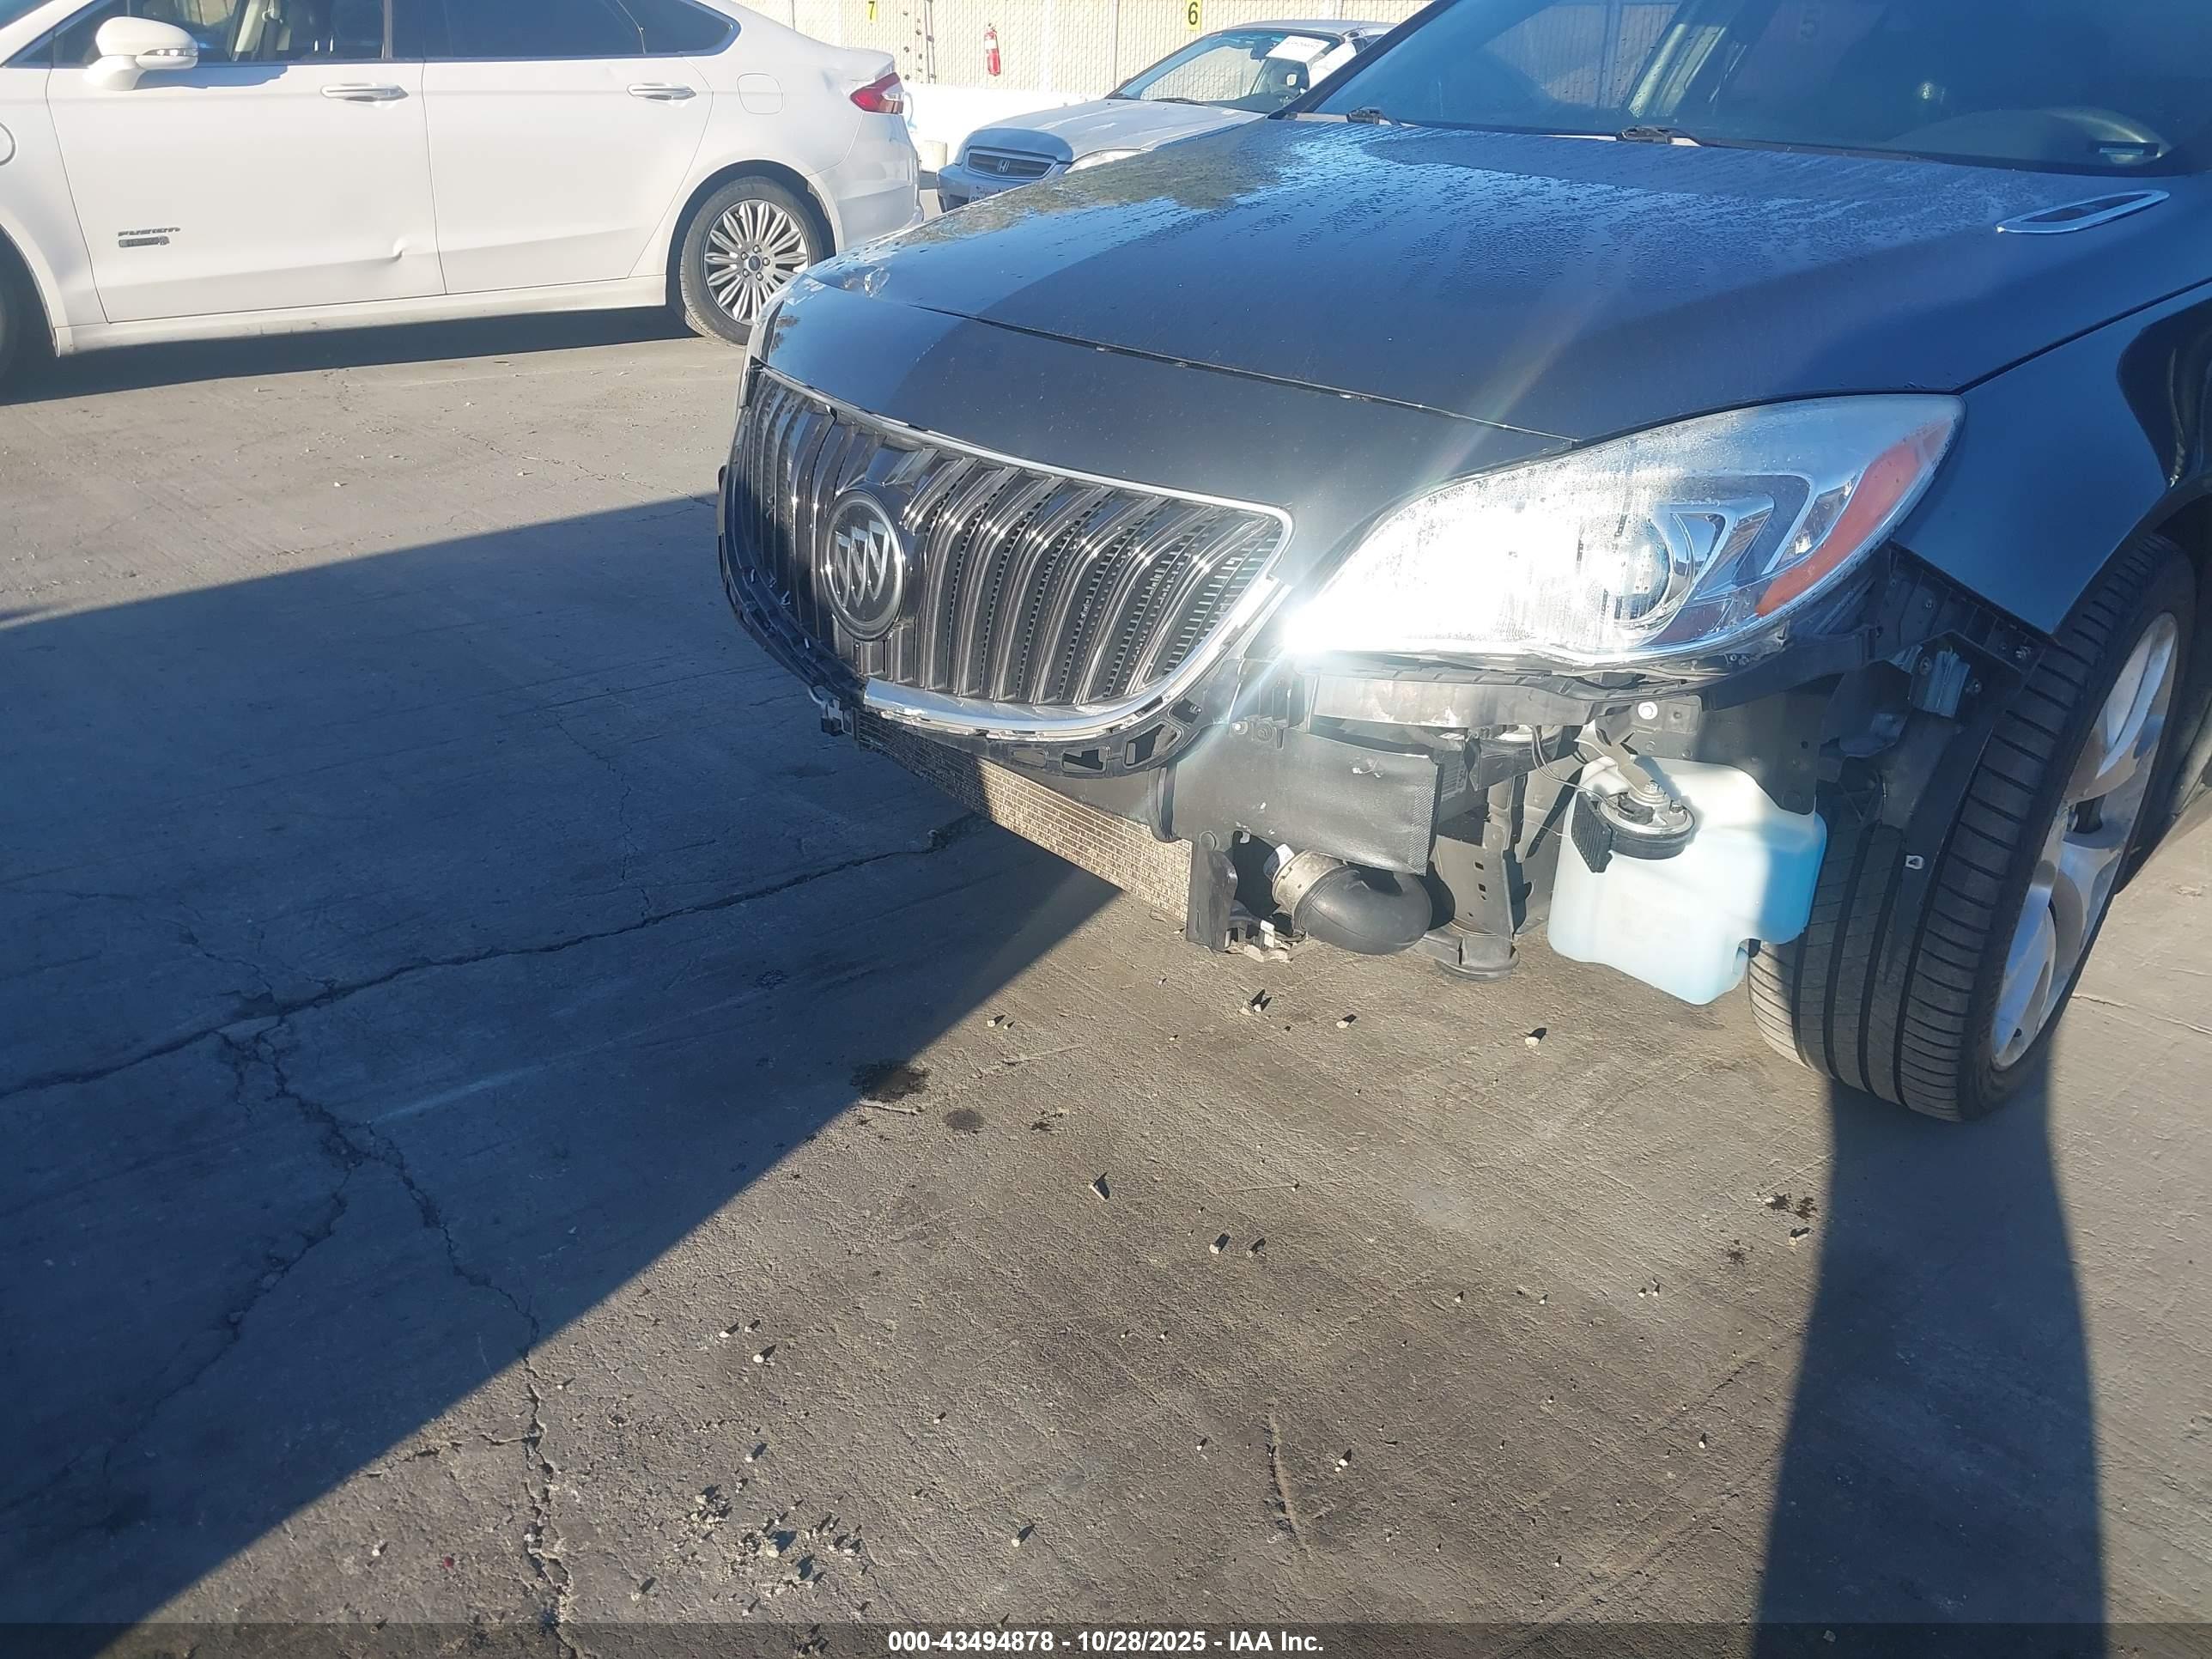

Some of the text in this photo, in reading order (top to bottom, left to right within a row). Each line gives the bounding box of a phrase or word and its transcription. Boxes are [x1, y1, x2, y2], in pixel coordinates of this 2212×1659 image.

[868, 1, 876, 21] 7
[1188, 2, 1199, 25] 6
[1801, 8, 1819, 40] 5
